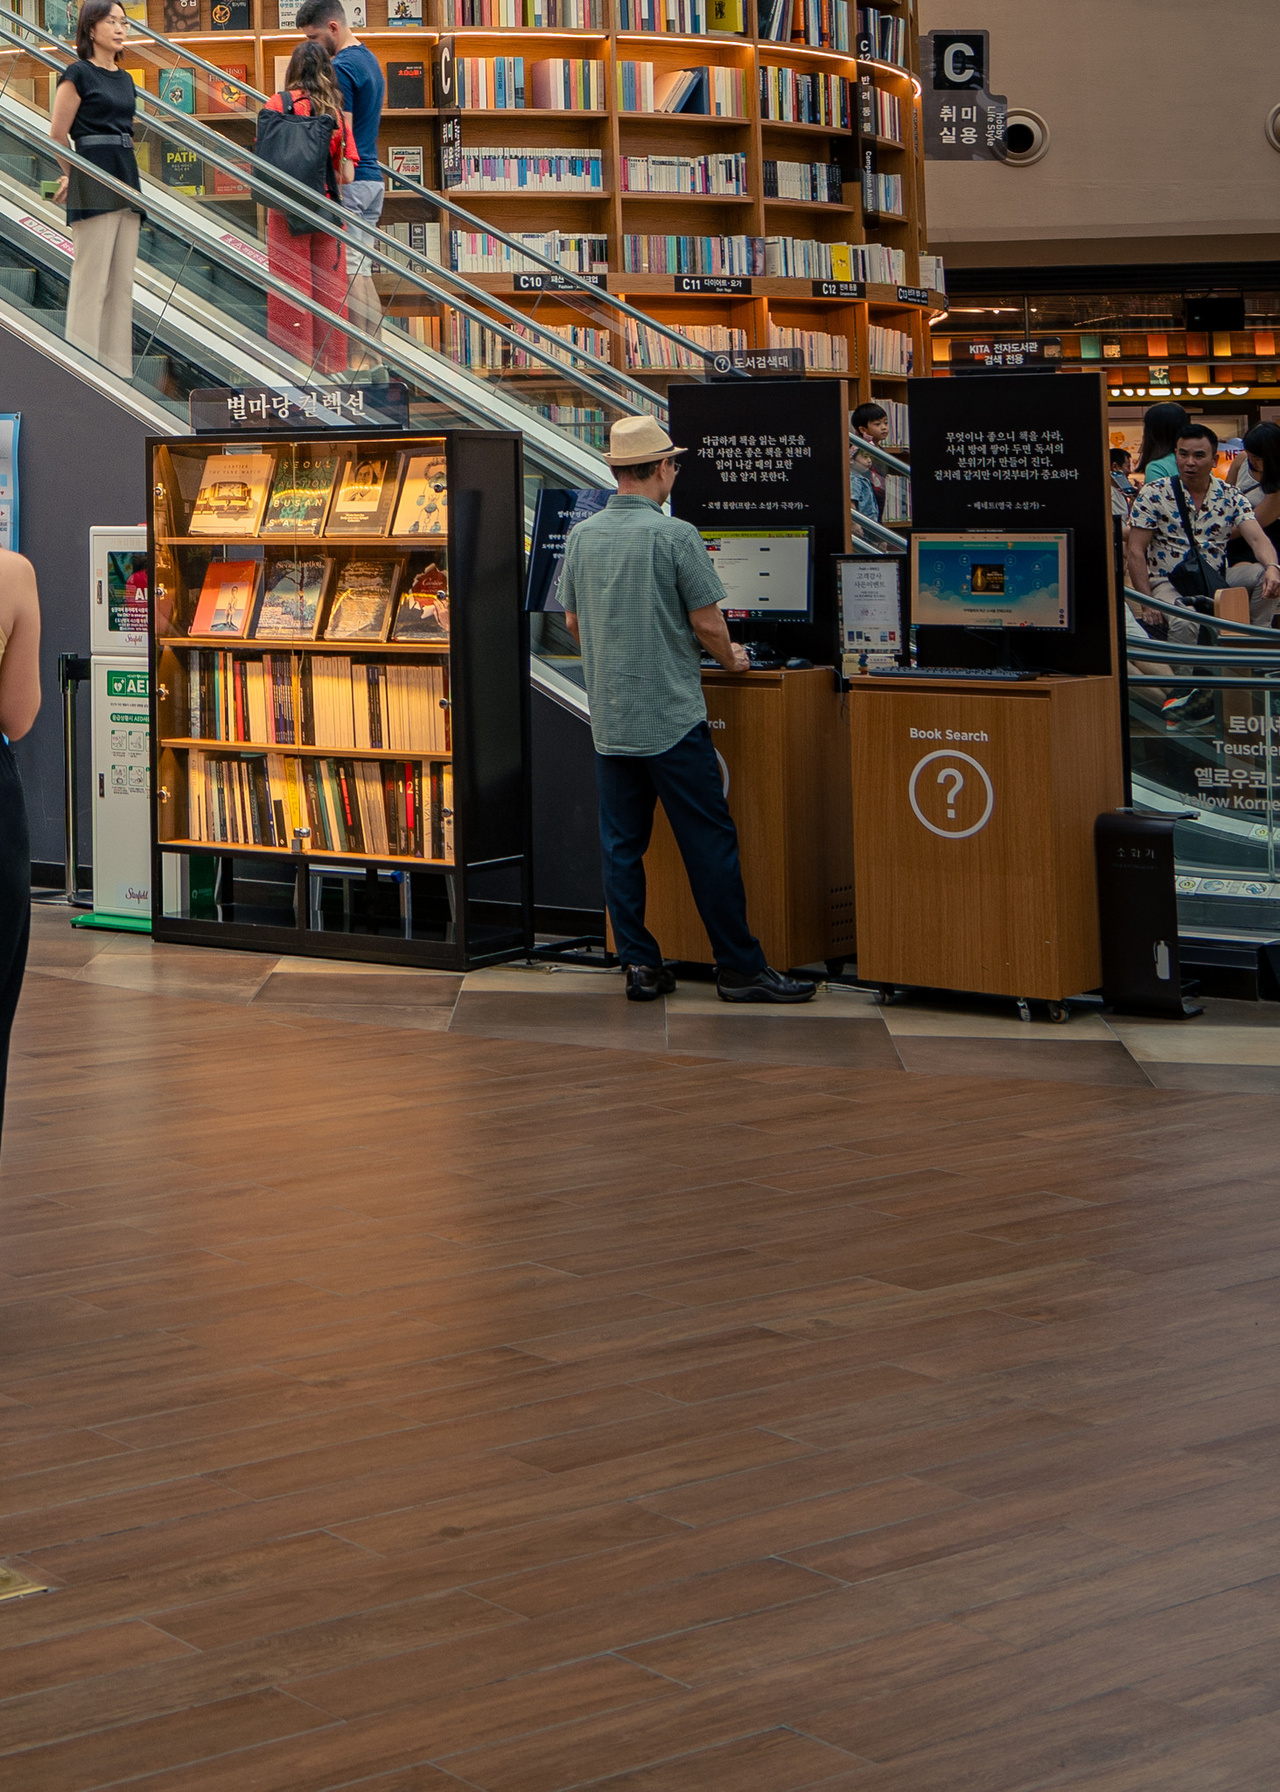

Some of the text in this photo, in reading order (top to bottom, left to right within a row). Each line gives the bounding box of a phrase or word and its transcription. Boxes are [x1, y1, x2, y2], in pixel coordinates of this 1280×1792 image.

[860, 40, 869, 52] C
[944, 43, 975, 82] C
[442, 47, 451, 94] C
[940, 106, 977, 122] 취미
[986, 106, 996, 146] Life Style
[996, 112, 1005, 140] Hobby
[940, 127, 978, 144] 실용
[167, 152, 197, 163] PATH
[865, 150, 874, 212] Companion Animal
[520, 276, 542, 288] C10
[683, 278, 700, 291] C11
[822, 284, 836, 295] C12
[970, 342, 1038, 354] KITA 전자도서관
[734, 356, 789, 369] 도서검색대
[984, 354, 1024, 365] 검색 전용
[227, 390, 365, 420] 별마당 컬렉션
[946, 431, 1064, 442] 무엇이나 좋으니 책을 사라.
[283, 461, 331, 470] SEOUL
[958, 457, 1053, 467] 분위기가 만들어 진다.
[720, 472, 789, 482] 힘을 알지 못한다.
[273, 499, 323, 507] BUSAN
[269, 519, 318, 527] SALE
[127, 679, 150, 693] AE
[910, 727, 988, 742] Book Search
[407, 781, 413, 794] 2
[1179, 793, 1230, 809] Yellow
